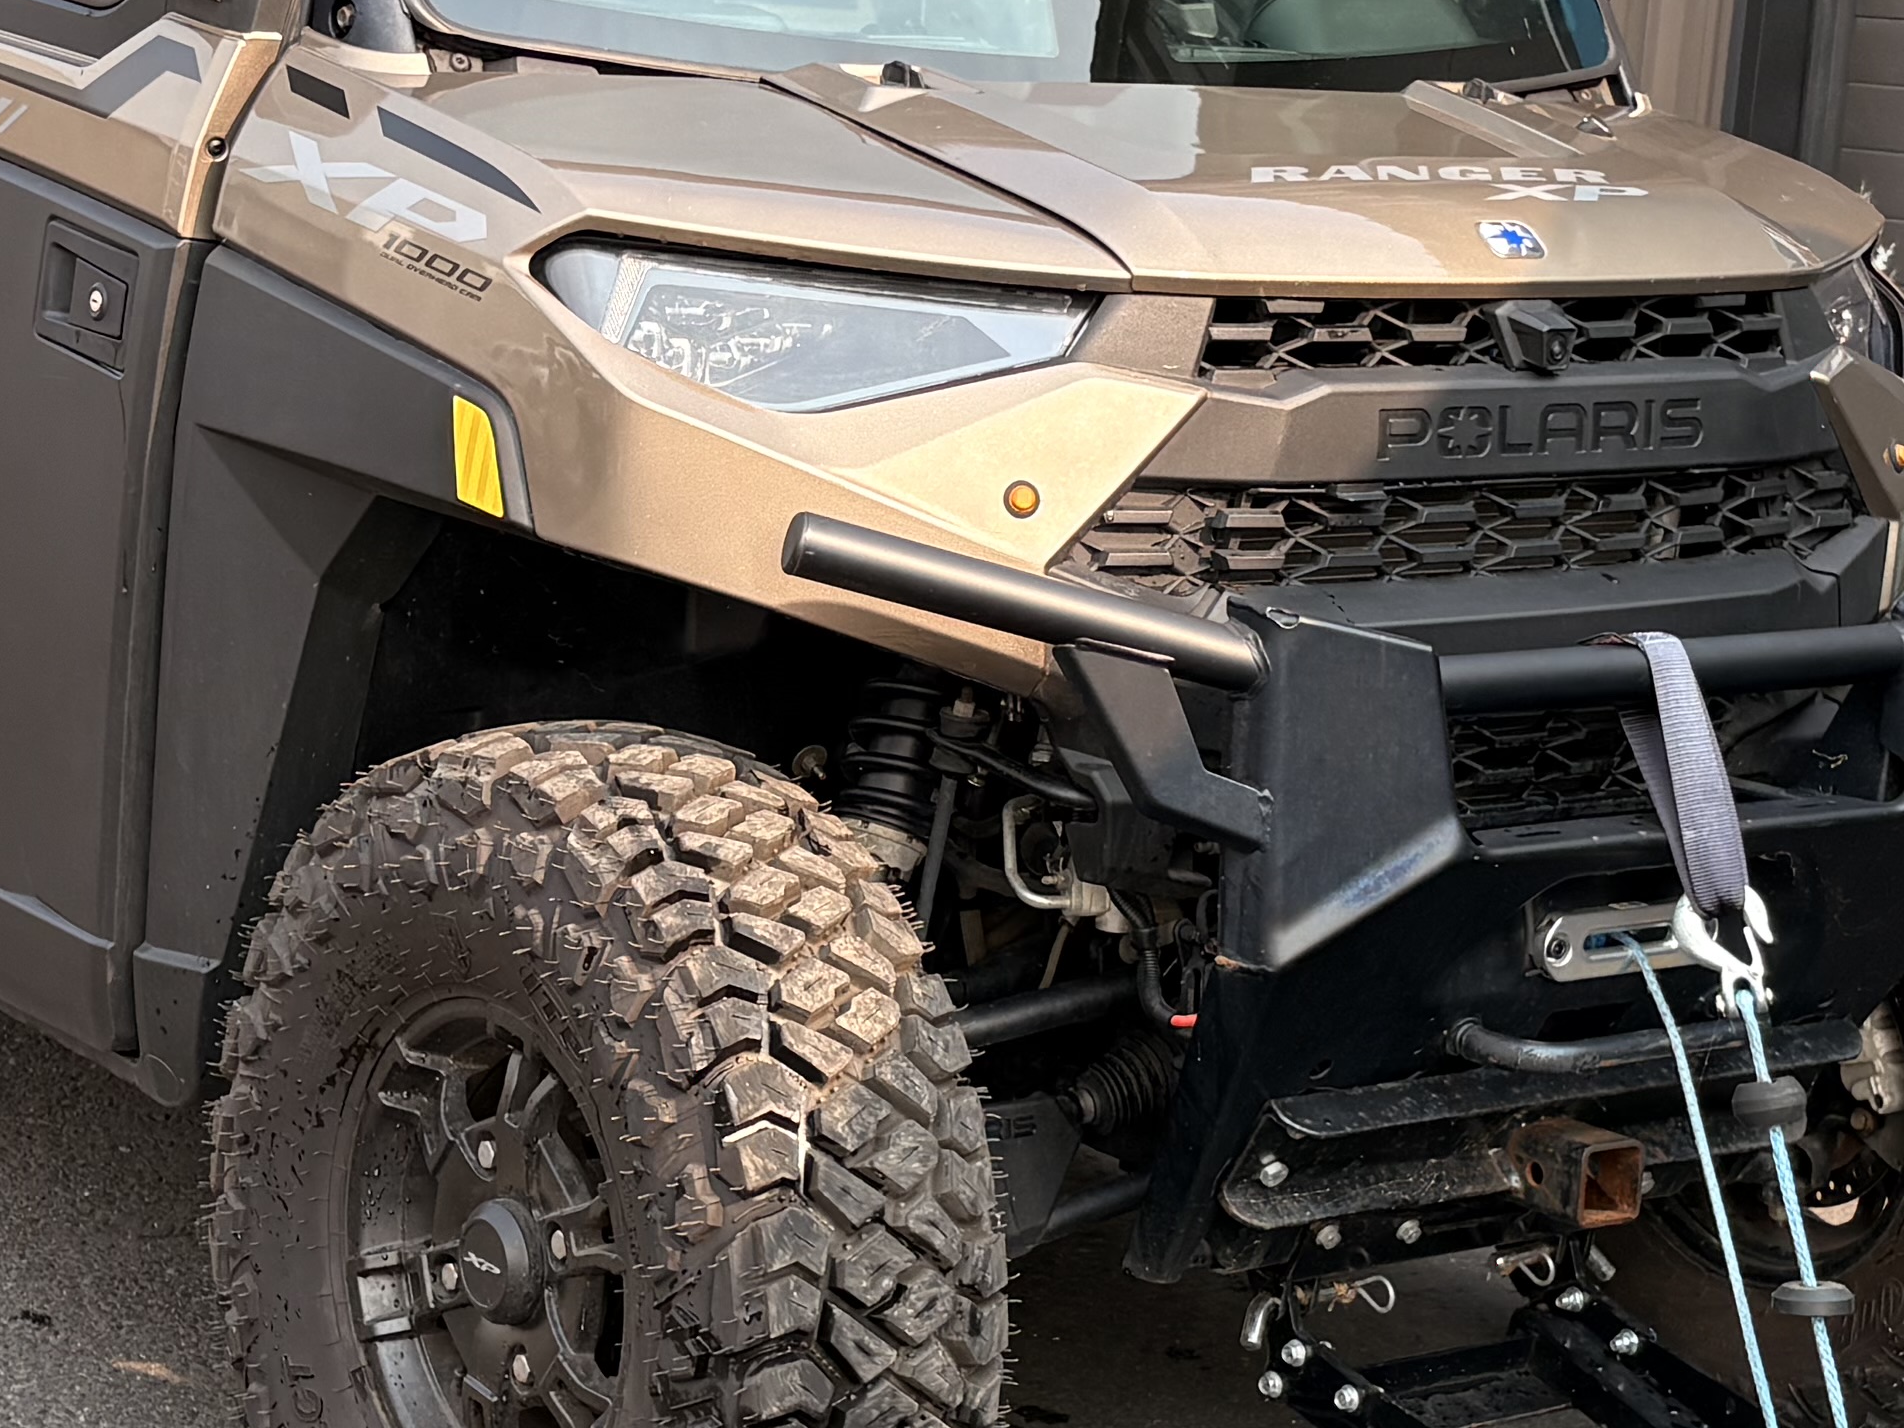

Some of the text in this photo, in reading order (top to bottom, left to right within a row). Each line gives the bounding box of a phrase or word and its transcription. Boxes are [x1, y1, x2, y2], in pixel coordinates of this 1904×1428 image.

[238, 129, 488, 244] XP
[1250, 164, 1610, 184] RANGER
[1484, 183, 1650, 202] XP
[382, 232, 494, 293] 1000
[1376, 397, 1704, 462] POLARIS
[463, 1251, 501, 1274] XP
